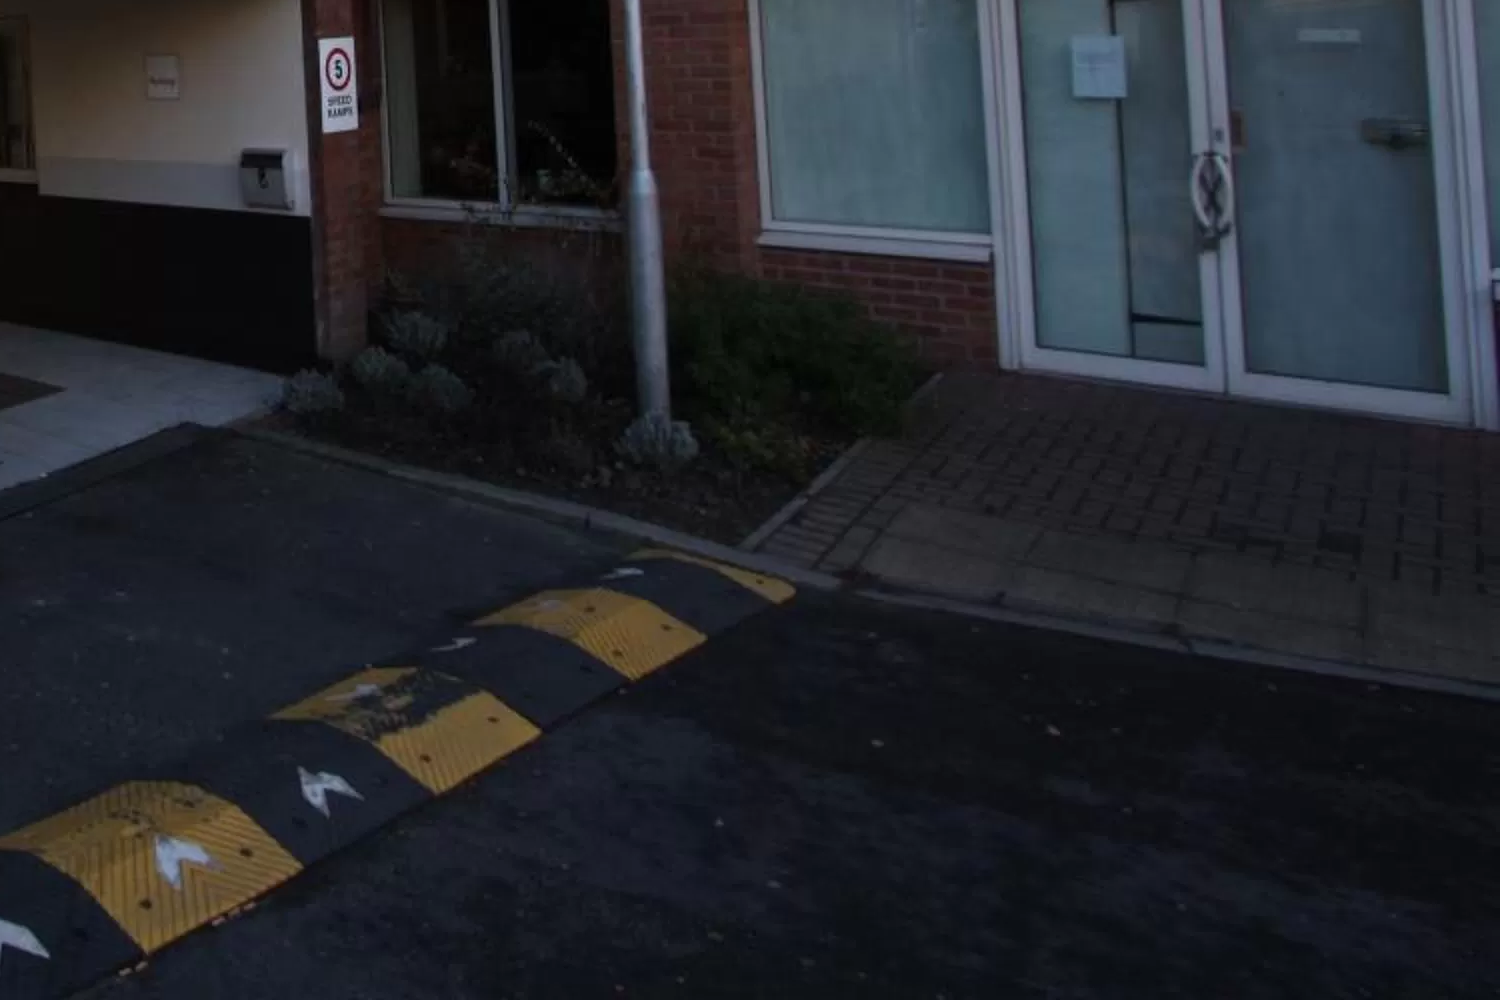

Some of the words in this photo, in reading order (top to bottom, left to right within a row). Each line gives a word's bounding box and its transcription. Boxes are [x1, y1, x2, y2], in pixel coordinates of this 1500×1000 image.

[334, 59, 343, 79] 5
[327, 95, 352, 107] SPEED
[327, 107, 353, 118] RAMPS
